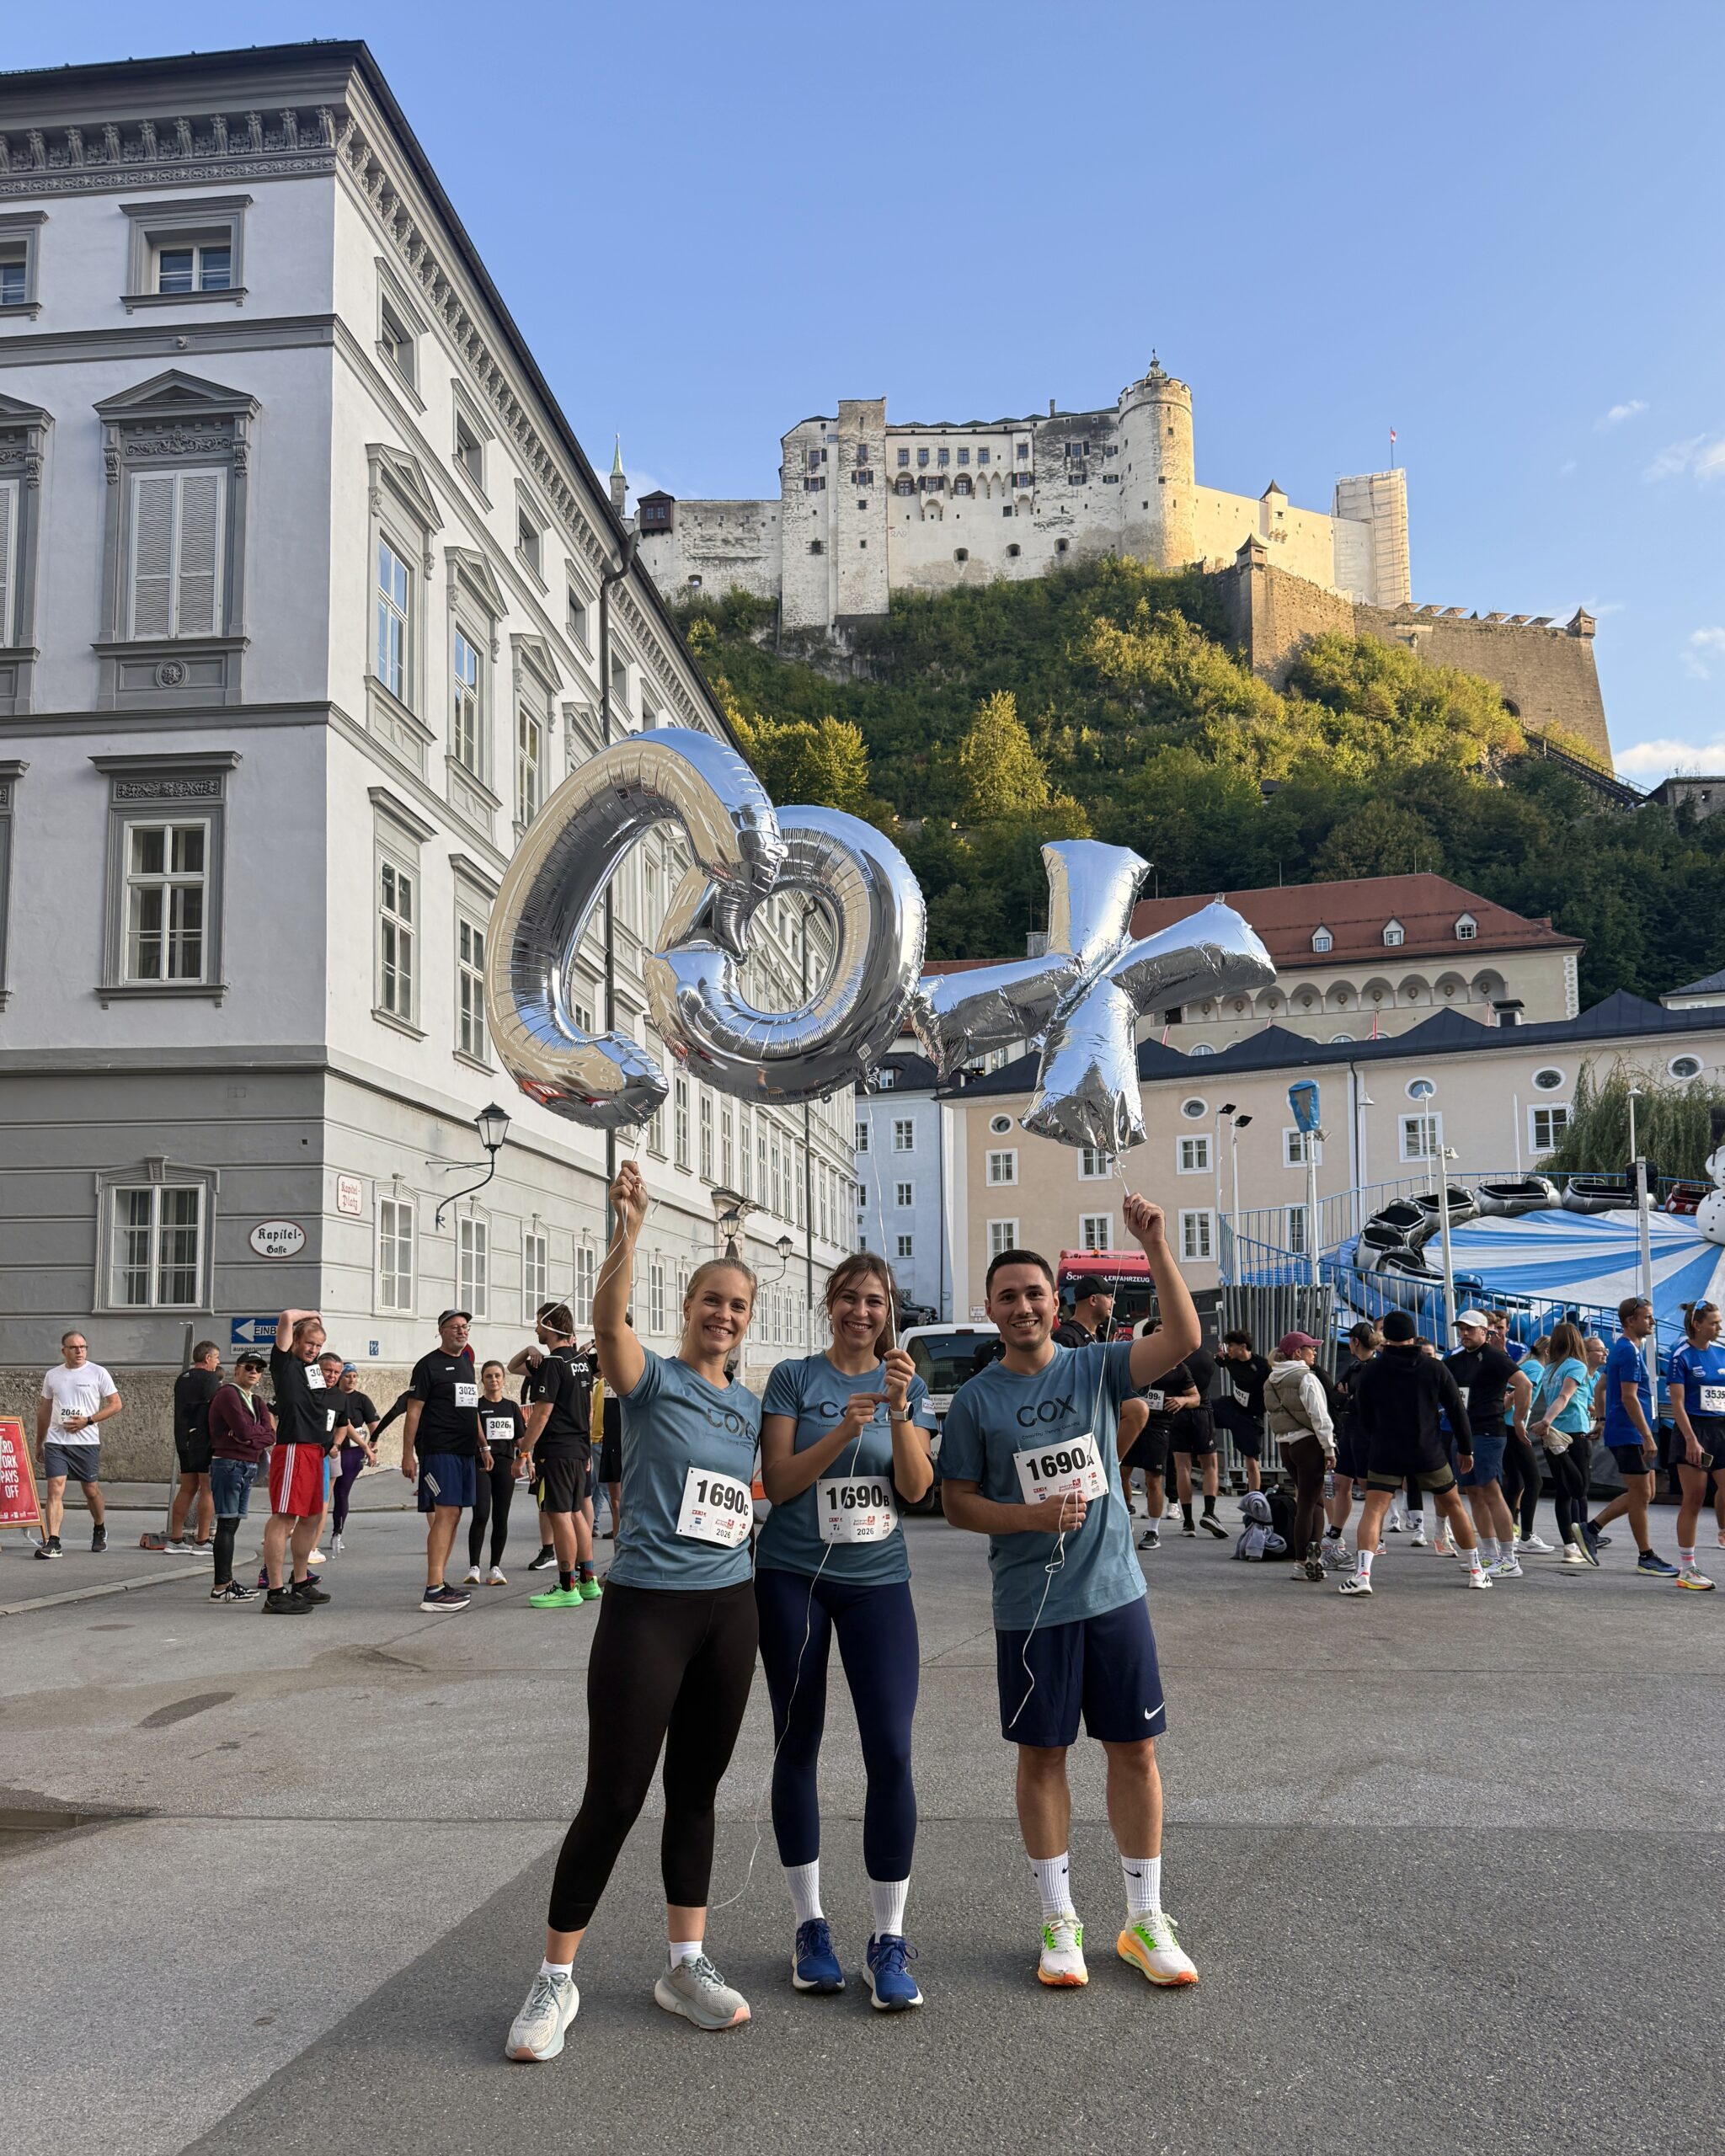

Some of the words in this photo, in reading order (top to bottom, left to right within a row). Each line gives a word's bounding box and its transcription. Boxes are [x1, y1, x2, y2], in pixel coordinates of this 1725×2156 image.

[258, 1228, 302, 1241] Kapitel-
[254, 1326, 276, 1335] EINB
[310, 1368, 323, 1377] 30
[1016, 1394, 1076, 1428] COX
[2, 1440, 13, 1454] RD
[1, 1454, 19, 1469] ORK
[1026, 1447, 1095, 1481] 1690A
[4, 1485, 19, 1498] OFF
[697, 1480, 749, 1516] 1690C
[825, 1485, 889, 1510] 1690B
[716, 1528, 731, 1539] 2026
